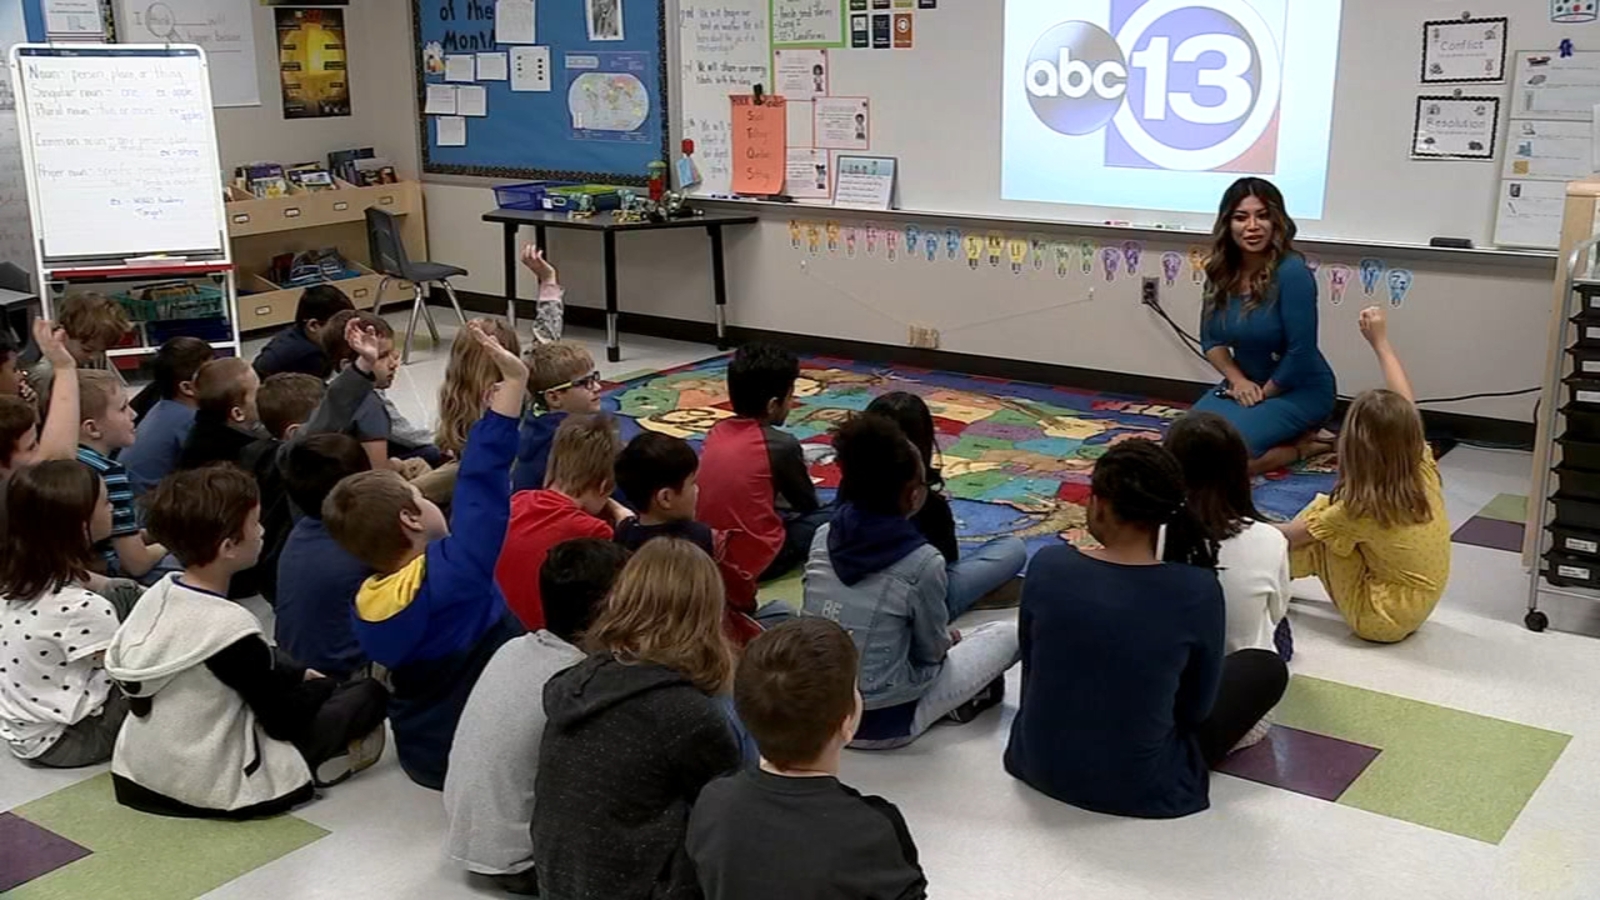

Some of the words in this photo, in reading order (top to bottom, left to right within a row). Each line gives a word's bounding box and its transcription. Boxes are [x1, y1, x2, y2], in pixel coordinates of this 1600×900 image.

[1440, 40, 1484, 51] Conflict
[1025, 47, 1127, 99] abc
[1132, 33, 1252, 124] 13
[1425, 117, 1486, 129] Resolution
[821, 600, 843, 621] BE
